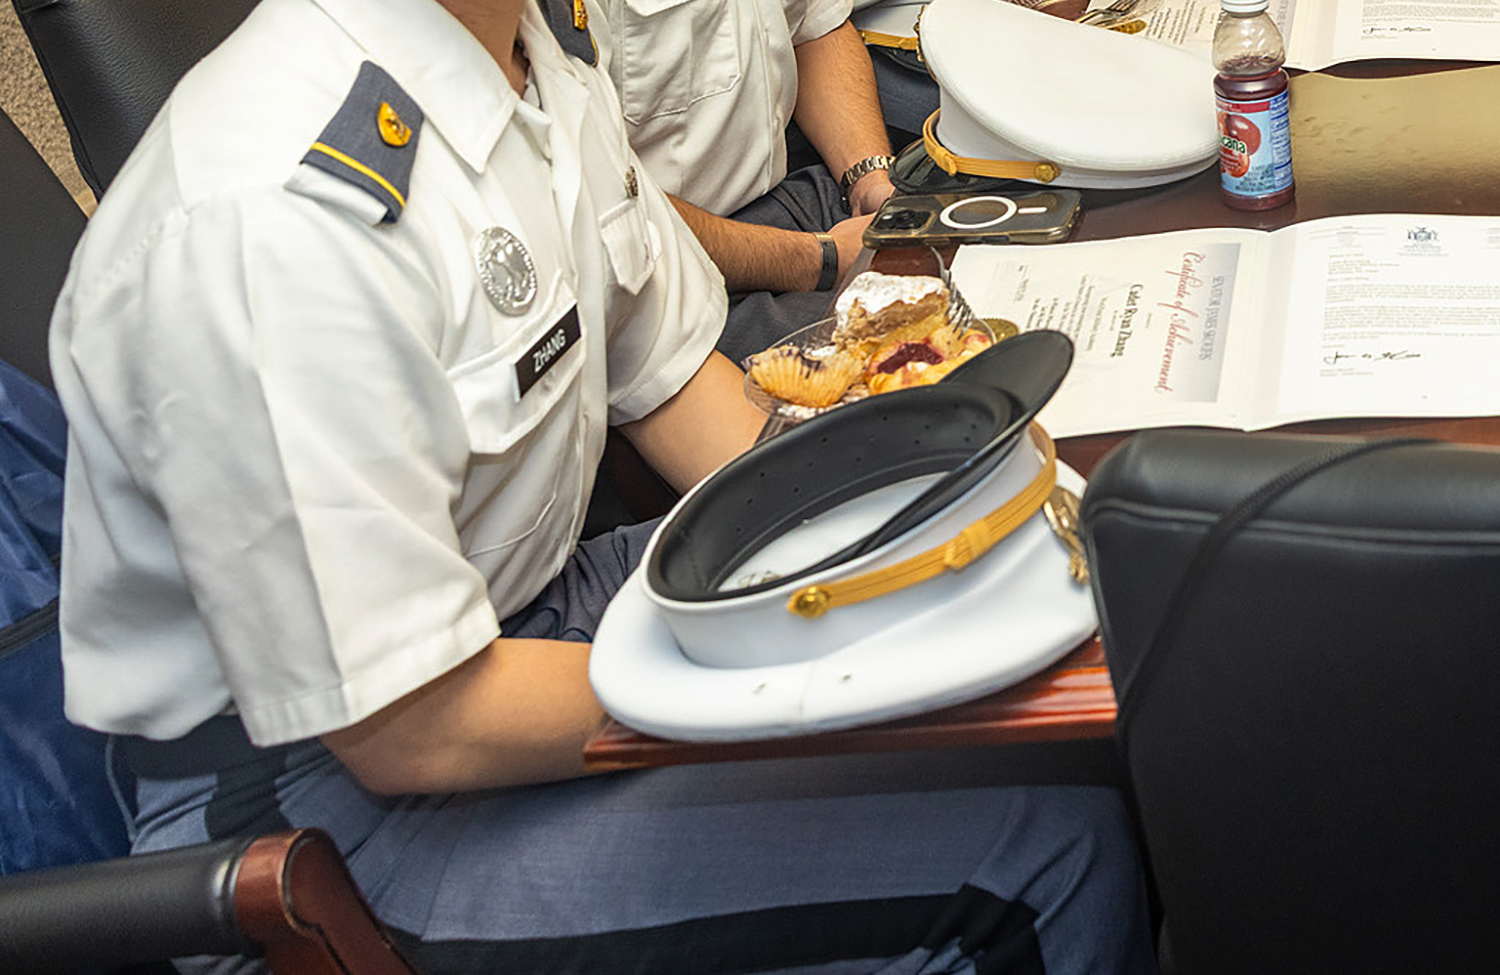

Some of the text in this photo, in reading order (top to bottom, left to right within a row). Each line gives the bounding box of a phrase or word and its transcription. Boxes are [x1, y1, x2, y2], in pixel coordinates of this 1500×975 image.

[532, 328, 566, 373] ZHANG
[1110, 283, 1144, 357] Cadet Ryan Zhang
[1154, 251, 1206, 394] Certificate of Achievement
